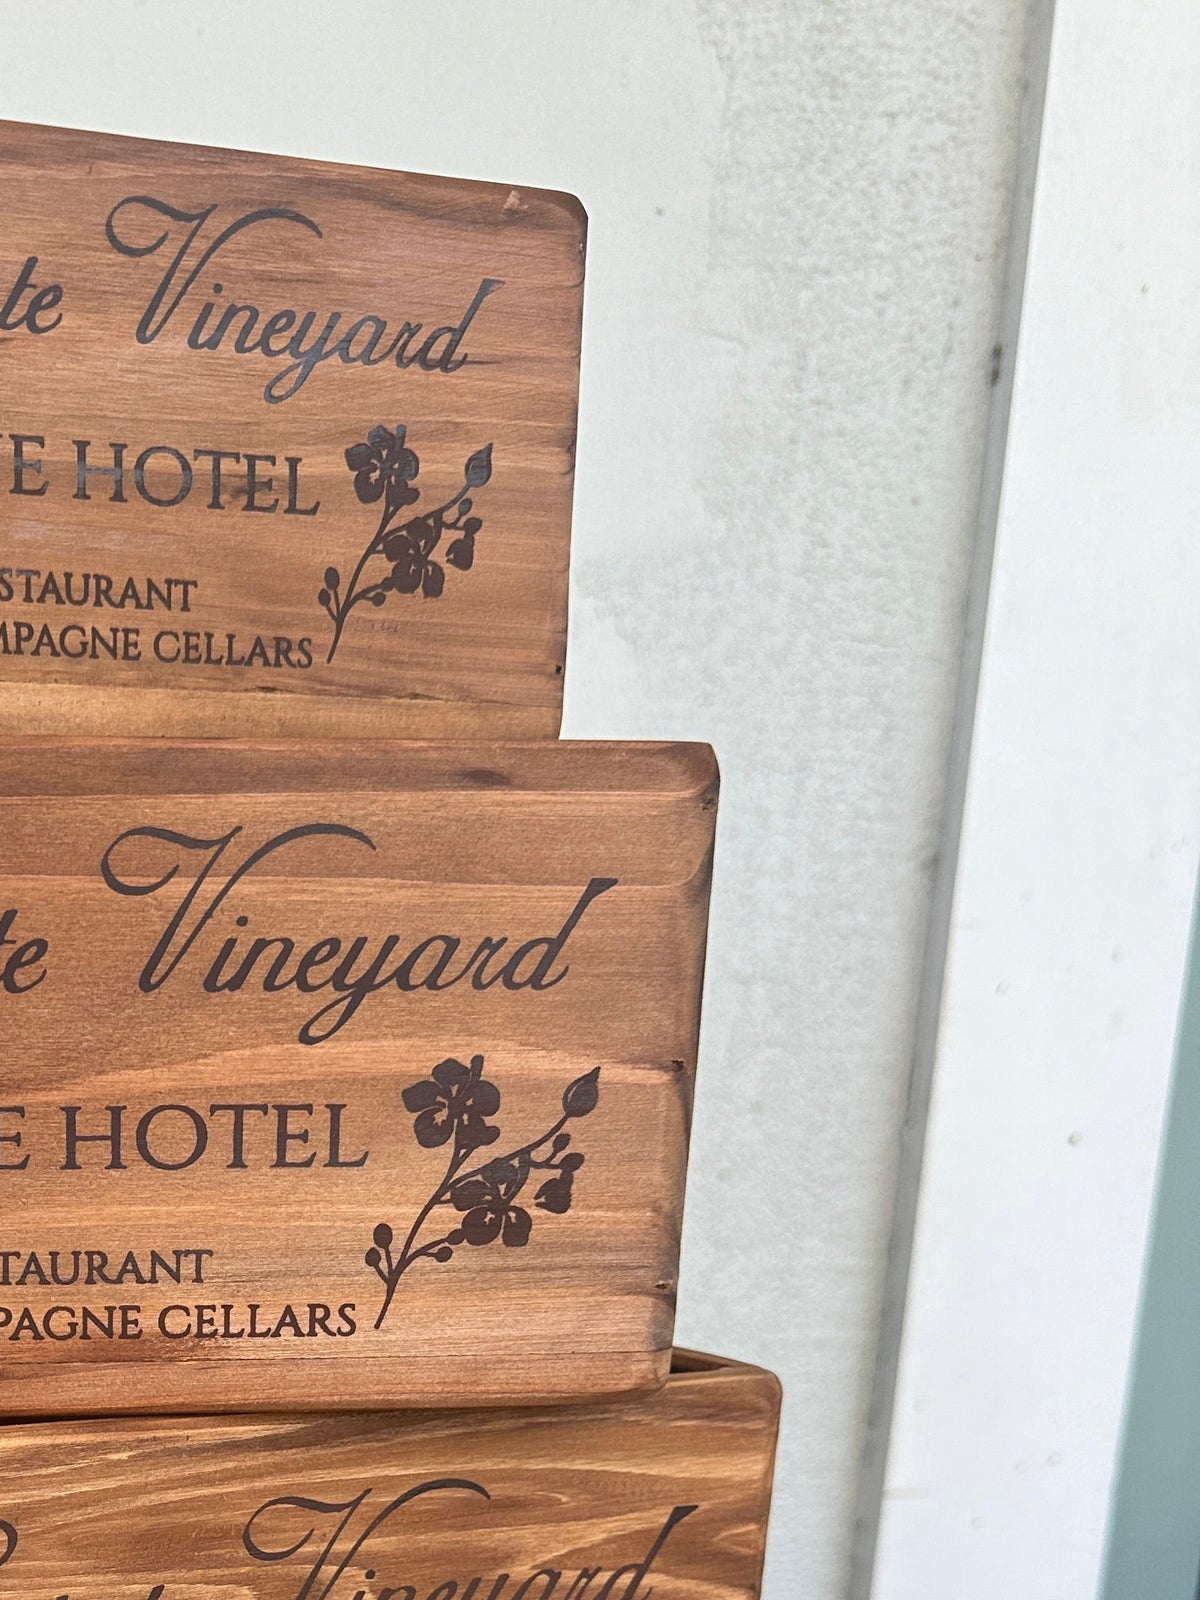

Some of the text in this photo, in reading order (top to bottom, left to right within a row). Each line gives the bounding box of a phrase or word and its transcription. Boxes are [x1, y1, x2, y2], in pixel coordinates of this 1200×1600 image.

[105, 194, 503, 405] Vineyard
[71, 441, 321, 518] HOTEL
[152, 629, 313, 670] CELLARS
[101, 821, 618, 1046] Vineyard
[60, 1101, 369, 1173] HOTEL
[158, 1302, 357, 1341] CELLARS
